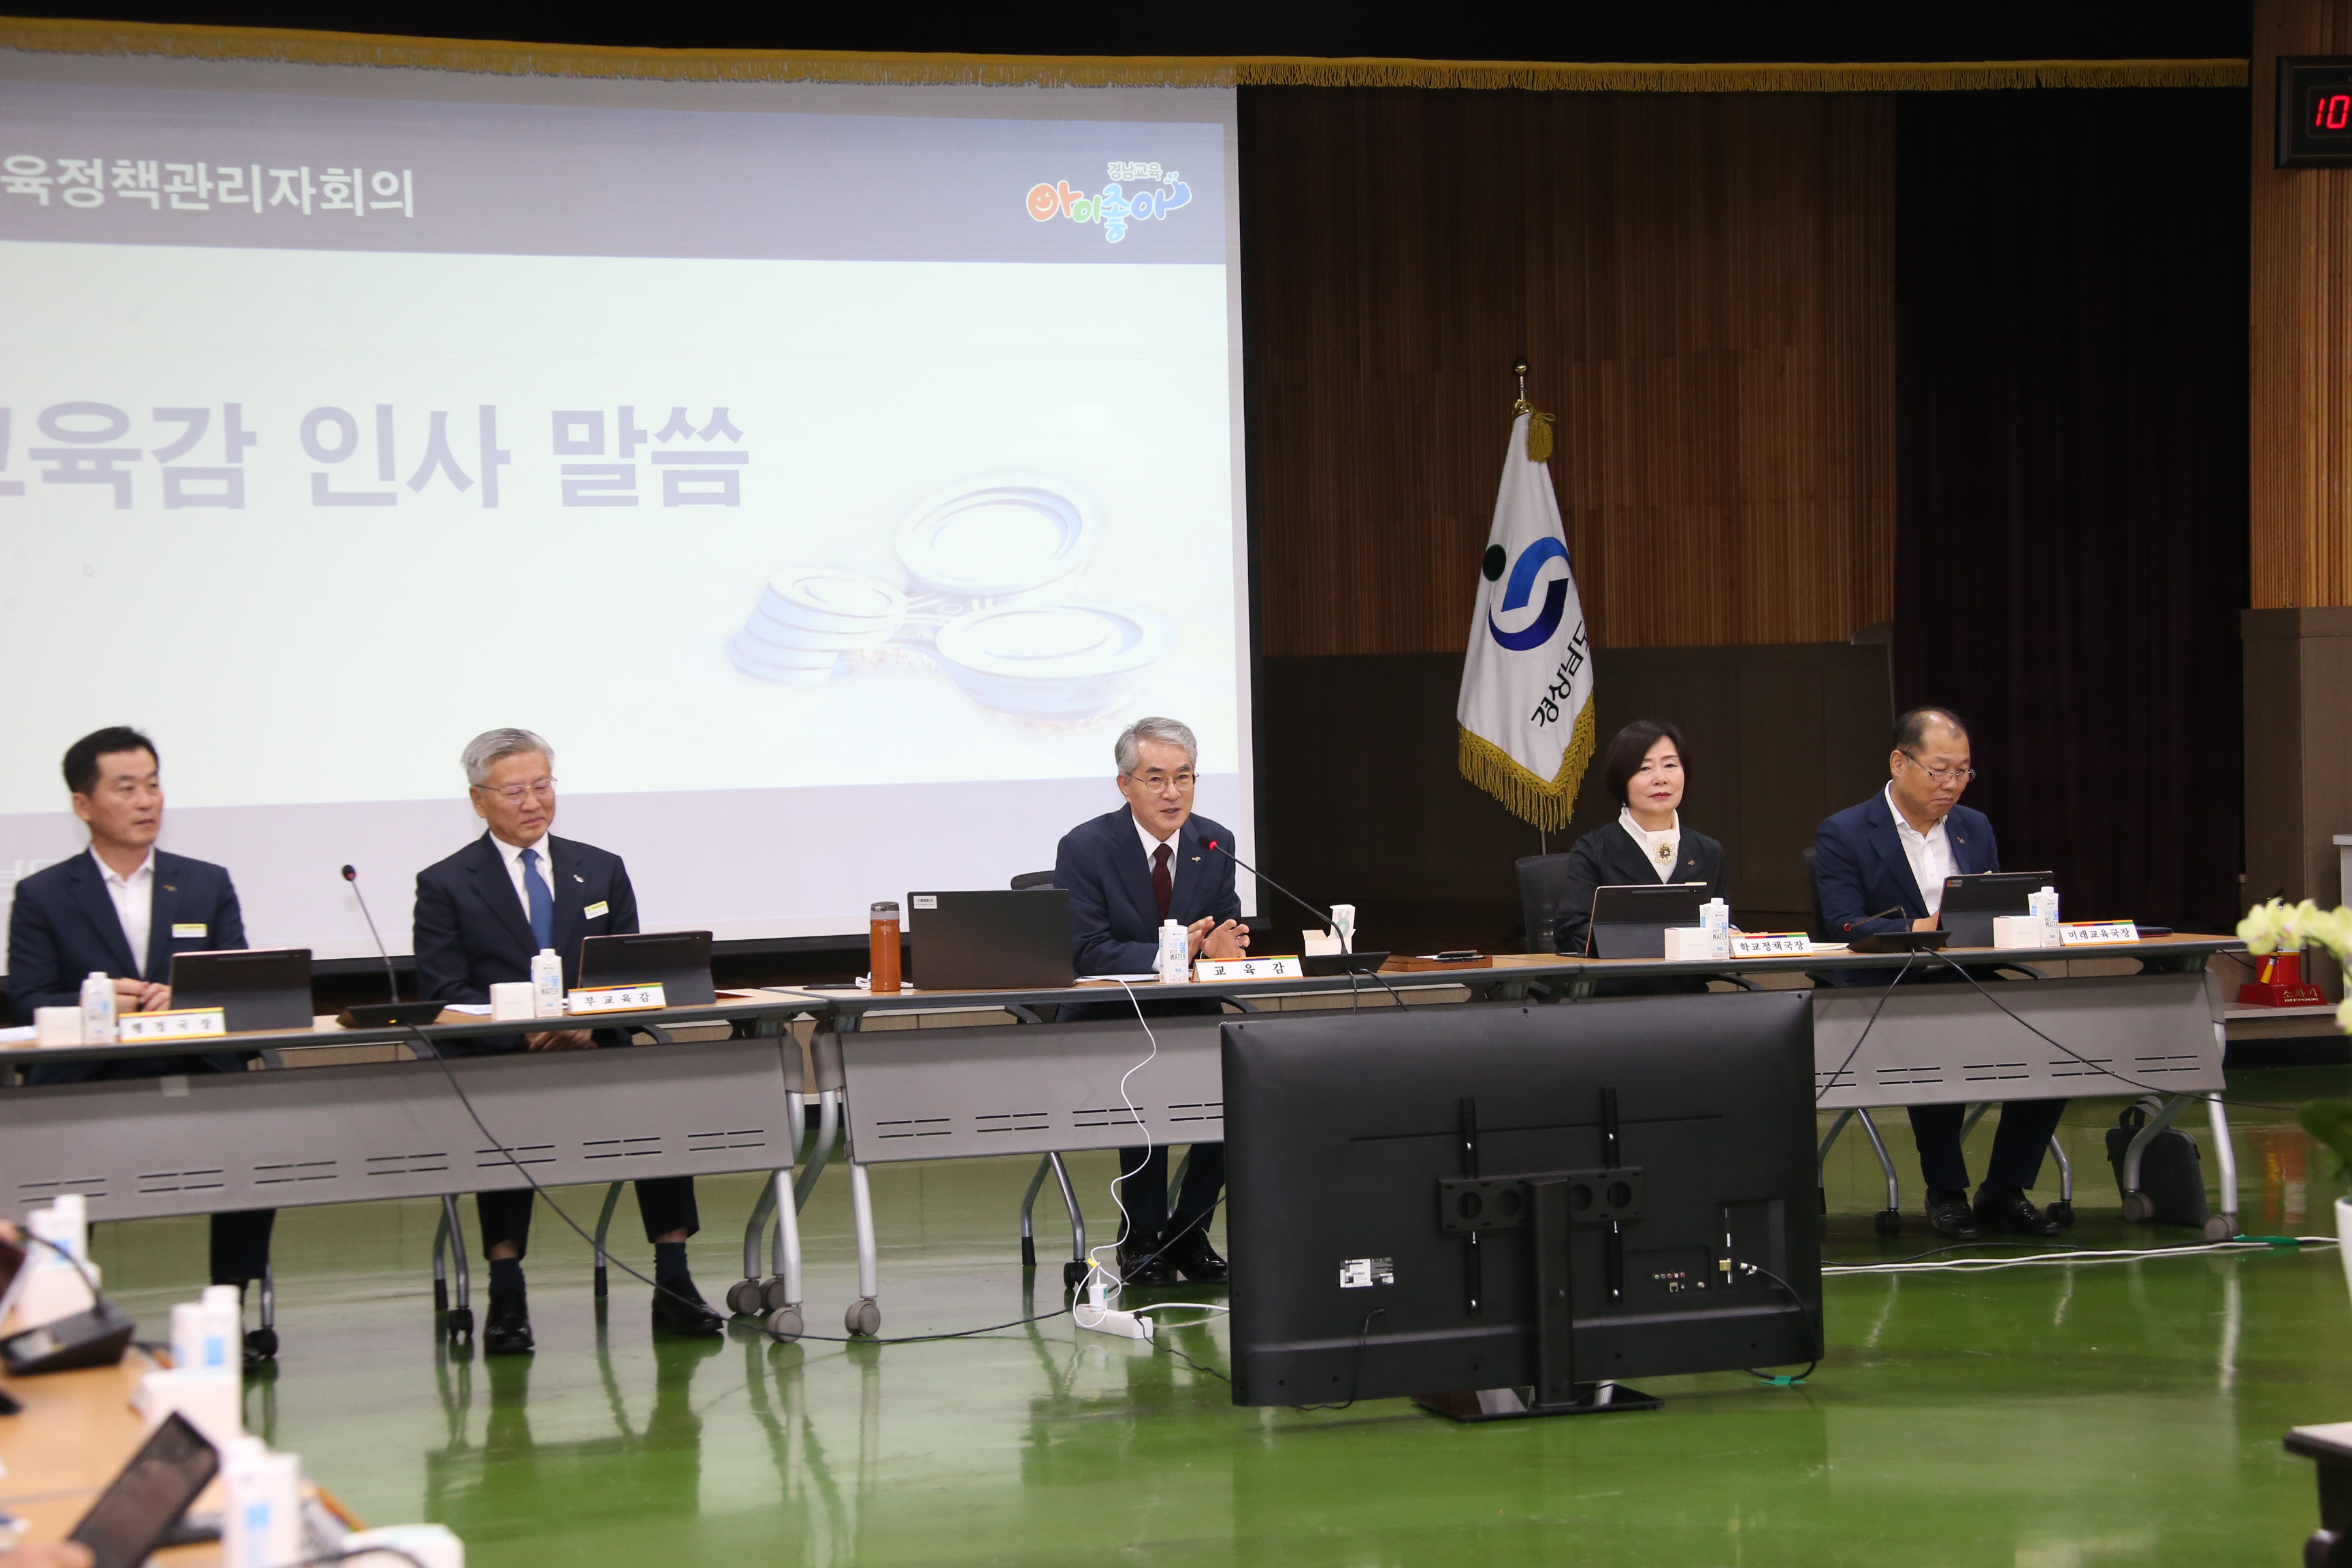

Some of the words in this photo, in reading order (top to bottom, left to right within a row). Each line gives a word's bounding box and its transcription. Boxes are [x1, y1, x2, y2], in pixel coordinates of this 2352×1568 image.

[2315, 95, 2351, 129] 10
[1107, 161, 1162, 181] 경남교육
[0, 154, 414, 218] 육정책관리자회의
[0, 400, 257, 510] 육감
[299, 404, 511, 509] 인사
[552, 405, 749, 508] 말씀
[1531, 620, 1588, 728] 경상남도
[1740, 941, 1804, 952] 학교정책국장
[2068, 928, 2130, 940] 미래교육국장
[2283, 987, 2318, 998] 소화기
